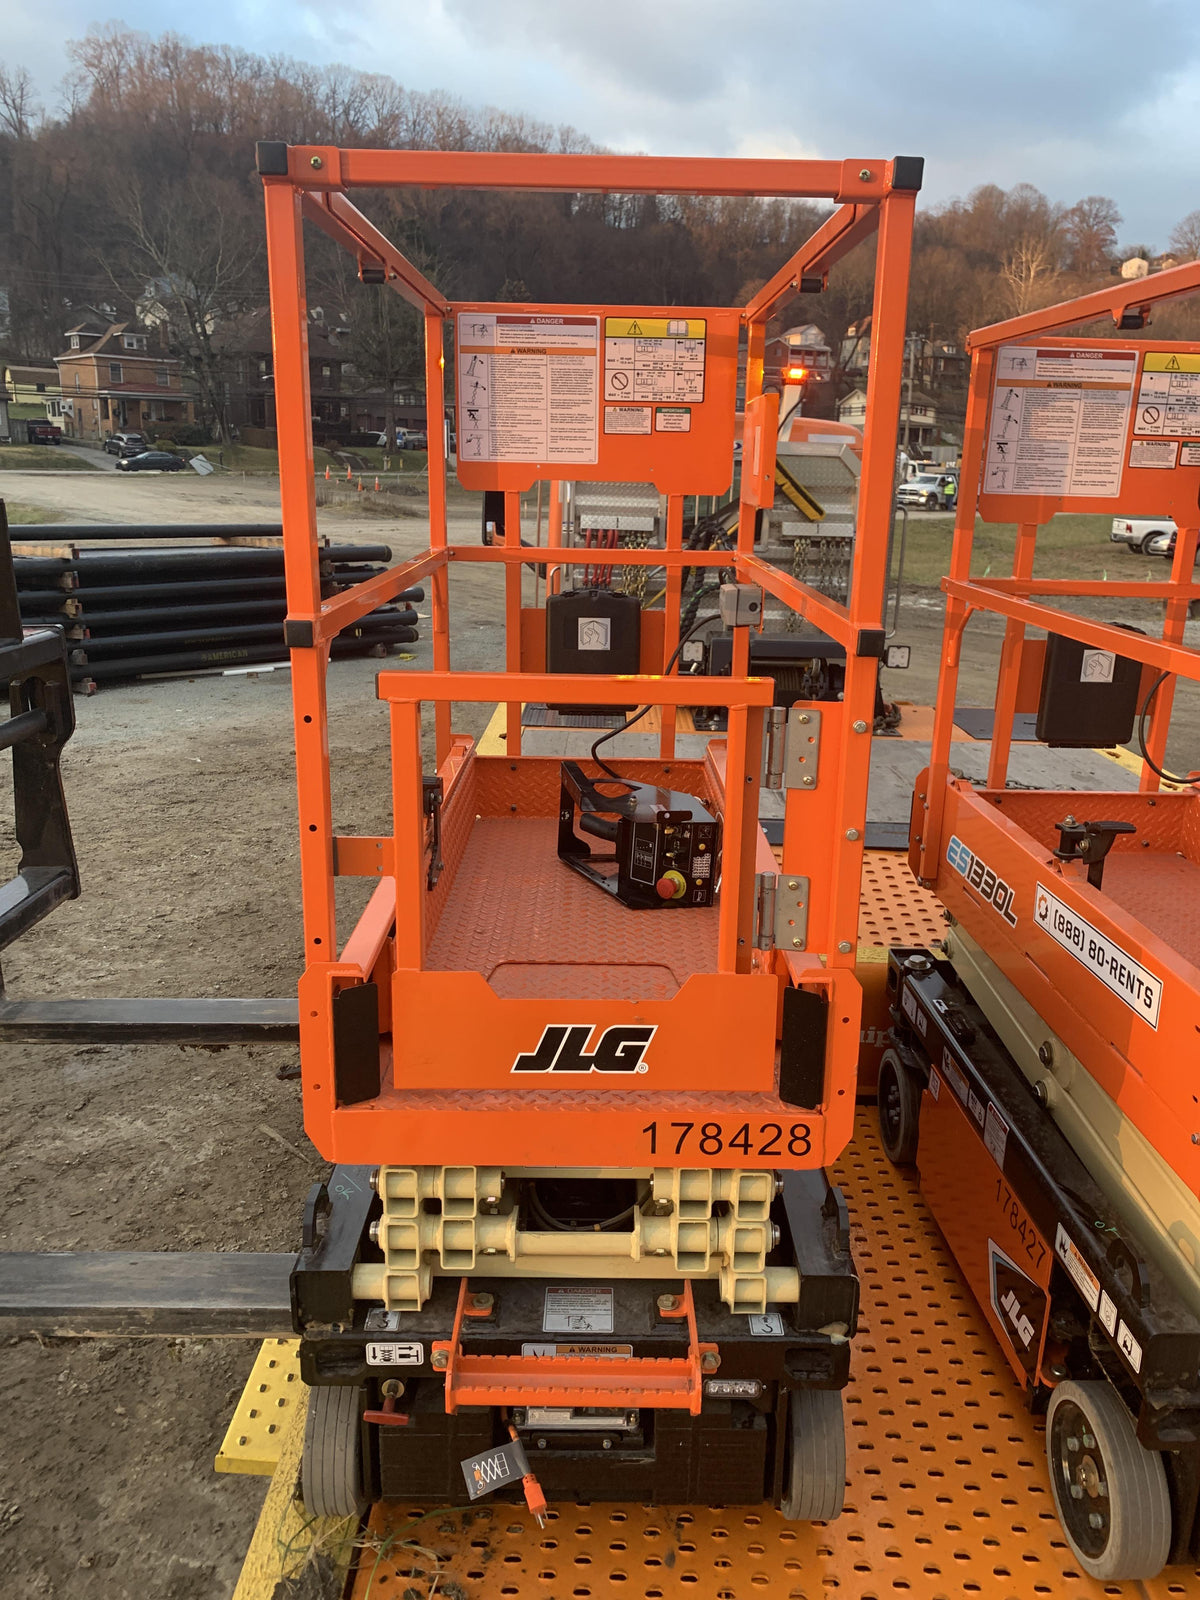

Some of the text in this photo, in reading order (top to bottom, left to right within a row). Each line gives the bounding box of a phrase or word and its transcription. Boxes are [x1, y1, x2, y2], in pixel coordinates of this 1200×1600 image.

[517, 347, 547, 355] WARNING
[1075, 352, 1103, 360] DANGER
[1052, 381, 1082, 389] WARNING
[207, 650, 248, 661] AMERICAN
[947, 836, 1017, 928] ES1330L
[1053, 909, 1153, 1009] (888) 80-RENTS
[510, 1024, 658, 1073] JLG
[642, 1121, 812, 1157] 178428
[996, 1179, 1046, 1269] 178427
[1000, 1290, 1035, 1348] JLG
